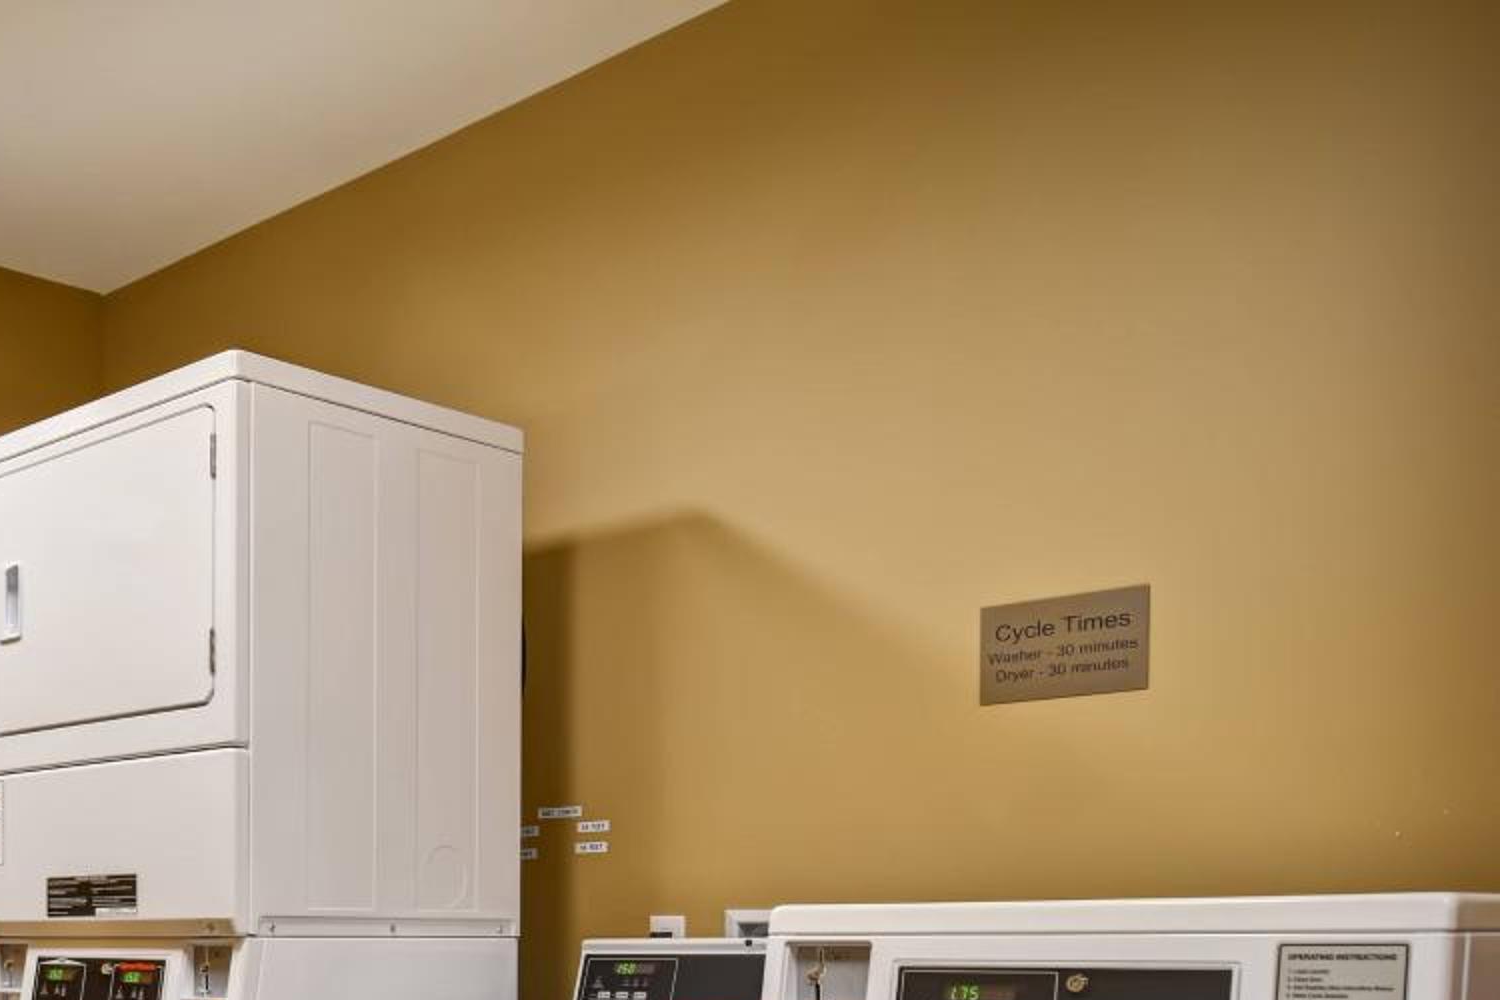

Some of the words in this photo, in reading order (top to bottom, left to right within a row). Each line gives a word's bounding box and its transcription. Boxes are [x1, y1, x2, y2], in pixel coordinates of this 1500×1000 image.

[995, 619, 1056, 645] Cycle
[1062, 612, 1132, 633] Times
[988, 649, 1042, 666] Washer
[1057, 643, 1075, 657] 30
[1079, 637, 1139, 654] minutes
[995, 668, 1035, 684] Dryer
[1071, 657, 1129, 673] minutes
